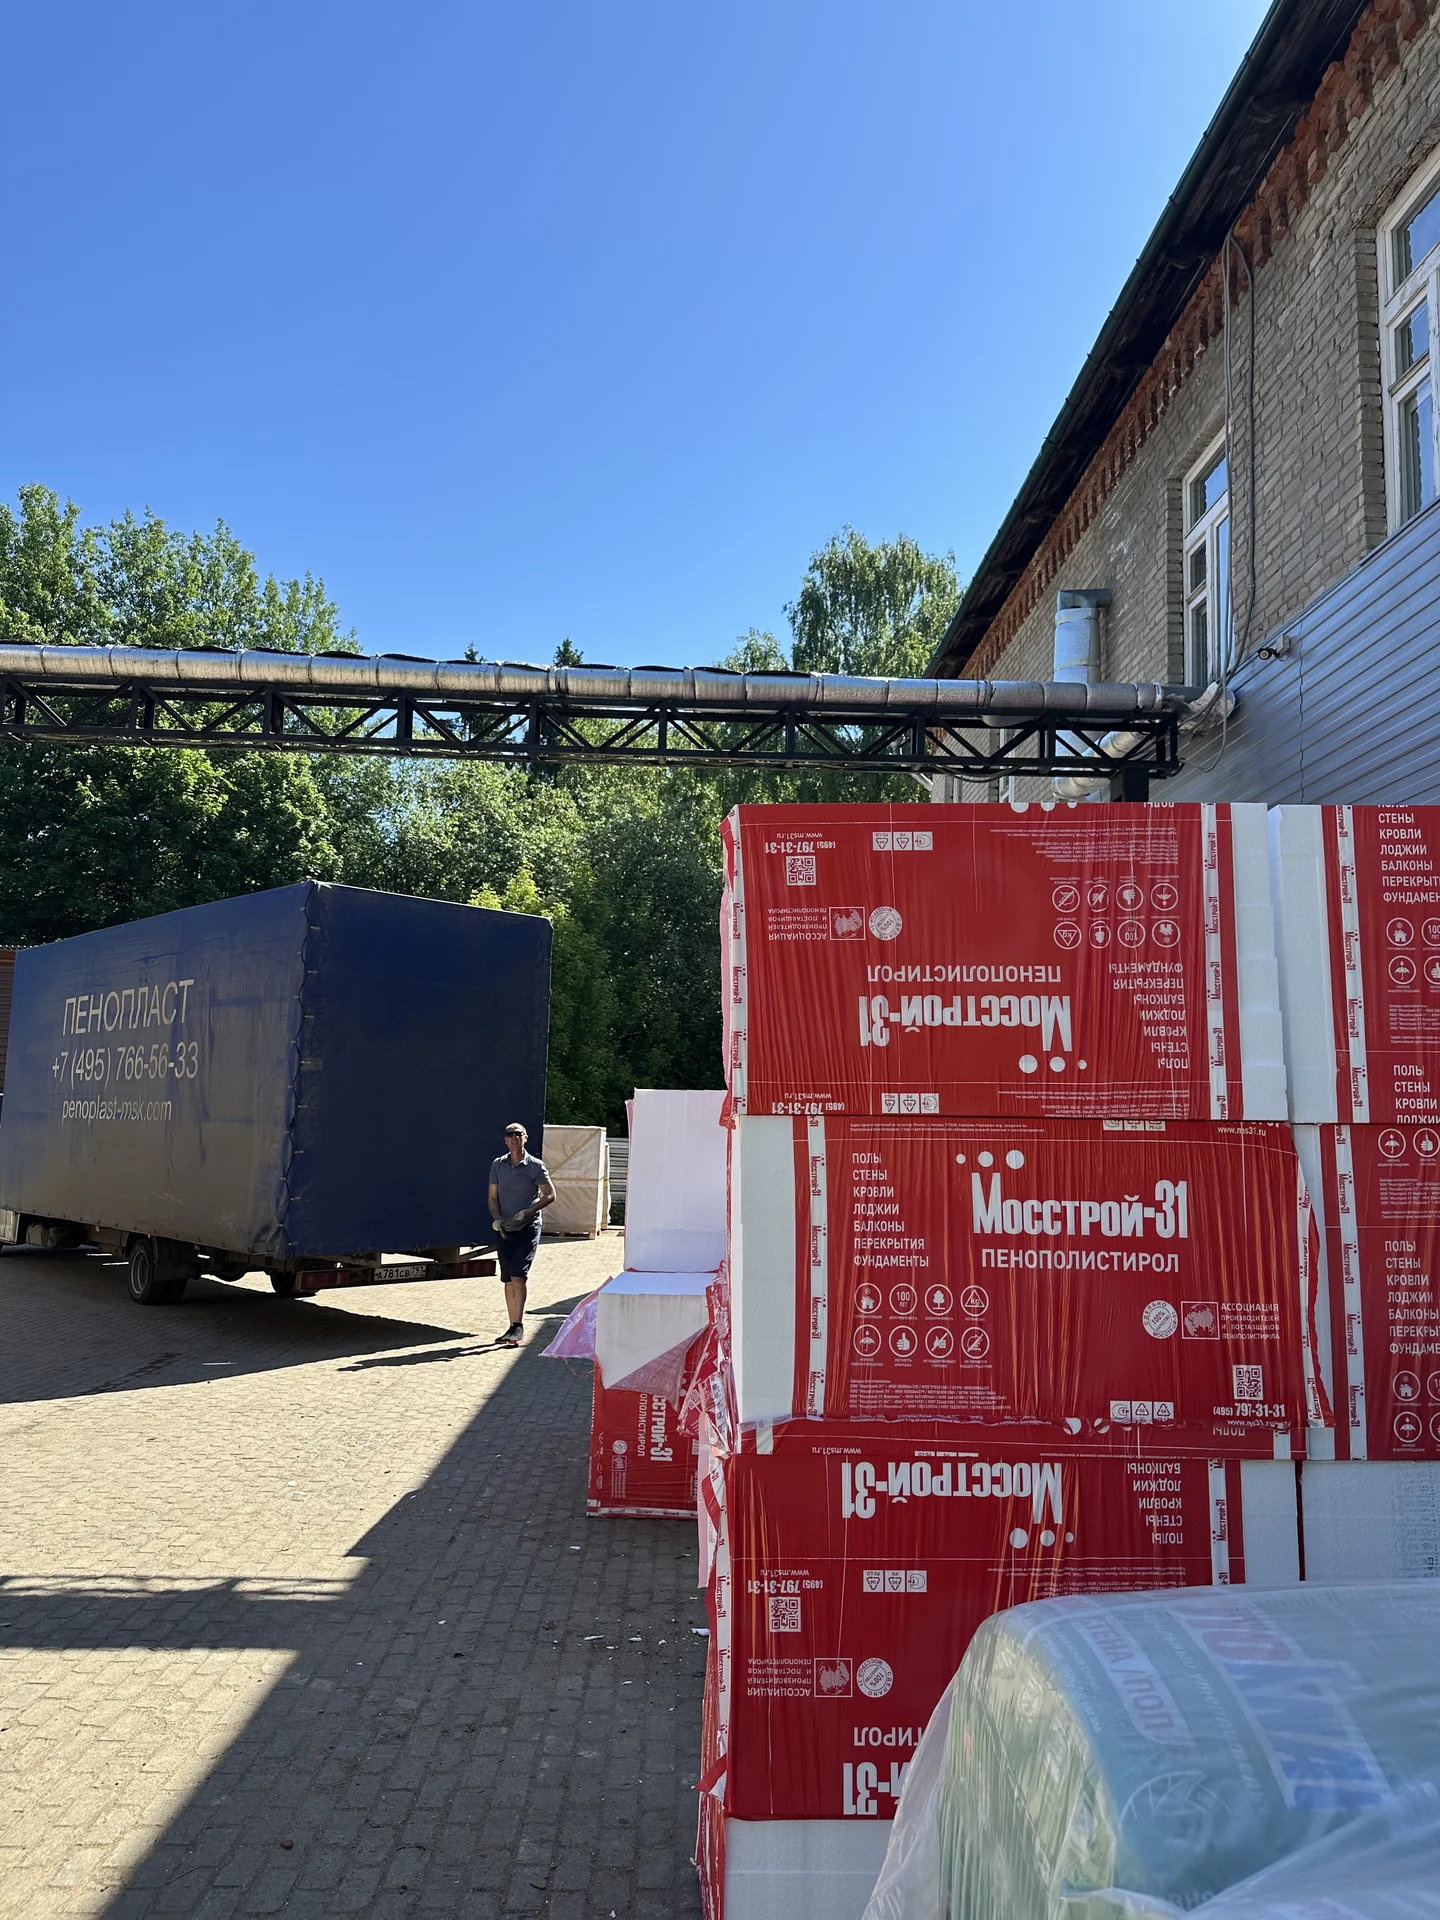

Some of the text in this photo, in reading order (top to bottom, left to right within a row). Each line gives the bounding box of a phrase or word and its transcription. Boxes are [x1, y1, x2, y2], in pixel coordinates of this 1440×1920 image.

[1378, 813, 1415, 824] СТЕНЫ
[776, 832, 823, 840] www.ms31.ru
[1379, 828, 1422, 839] КРОВЛИ
[765, 841, 836, 854] (495) 797-31-31
[1380, 844, 1427, 857] ЛОДЖИИ
[1381, 860, 1433, 871] БАЛКОНЫ
[768, 932, 827, 941] АССОЦИАЦИЯ
[867, 964, 1061, 983] ПЕНОПОЛИСТИРОЛ
[1109, 963, 1183, 973] ФУНДАМЕНТЫ
[1113, 978, 1184, 989] ПЕРЕКРЫТИЯ
[1133, 994, 1184, 1005] БАЛКОНЫ
[62, 979, 195, 1036] ПЕНОПЛАСТ
[1139, 1009, 1186, 1021] ЛОДЖИИ
[1143, 1026, 1187, 1036] КРОВЛИ
[1151, 1042, 1187, 1052] СТЕНЫ
[52, 1041, 199, 1090] +7 (495) 766-56-33
[1157, 1058, 1189, 1069] ПОЛЫ
[1393, 1065, 1424, 1076] ПОЛЫ
[1394, 1081, 1430, 1093] СТЕНЫ
[772, 1102, 845, 1115] (495) 797-31-31
[1395, 1098, 1437, 1110] КРОВЛИ
[61, 1095, 172, 1126] penoplast-msk.com
[1217, 1126, 1267, 1136] www.ms31.ru
[852, 1152, 882, 1164] ПОЛЫ
[852, 1169, 887, 1181] СТЕНЫ
[853, 1186, 895, 1198] КРОВЛИ
[852, 1203, 900, 1215] ЛОДЖИИ
[853, 1220, 905, 1232] БАЛКОНЫ
[853, 1237, 925, 1250] ПЕРЕКРЫТИЯ
[1384, 1240, 1416, 1252] ПОЛЫ
[853, 1254, 929, 1268] ФУНДАМЕНТЫ
[981, 1248, 1179, 1272] ПЕНОПОЛИСТИРОЛ
[1385, 1257, 1421, 1269] СТЕНЫ
[1386, 1274, 1429, 1286] КРОВЛИ
[896, 1291, 910, 1301] 100
[970, 1297, 980, 1307] kg
[1387, 1291, 1433, 1305] ЛОДЖИИ
[1221, 1303, 1279, 1313] АССОЦИАЦИЯ
[1388, 1308, 1440, 1320] БАЛКОНЫ
[1213, 1403, 1286, 1418] (495) 797-31-31
[637, 1394, 648, 1457] ОПОЛИСТИРОЛ
[812, 1446, 862, 1454] www.ms31.ru
[1127, 1462, 1181, 1474] БАЛКОНЫ
[1133, 1480, 1182, 1492] ЛОДЖИИ
[1138, 1498, 1182, 1509] КРОВЛИ
[1145, 1515, 1183, 1527] СТЕНЫ
[1152, 1532, 1183, 1544] ПОЛЫ
[747, 1580, 823, 1594] (495) 797-31-31
[747, 1687, 812, 1697] АССОЦИАЦИЯ
